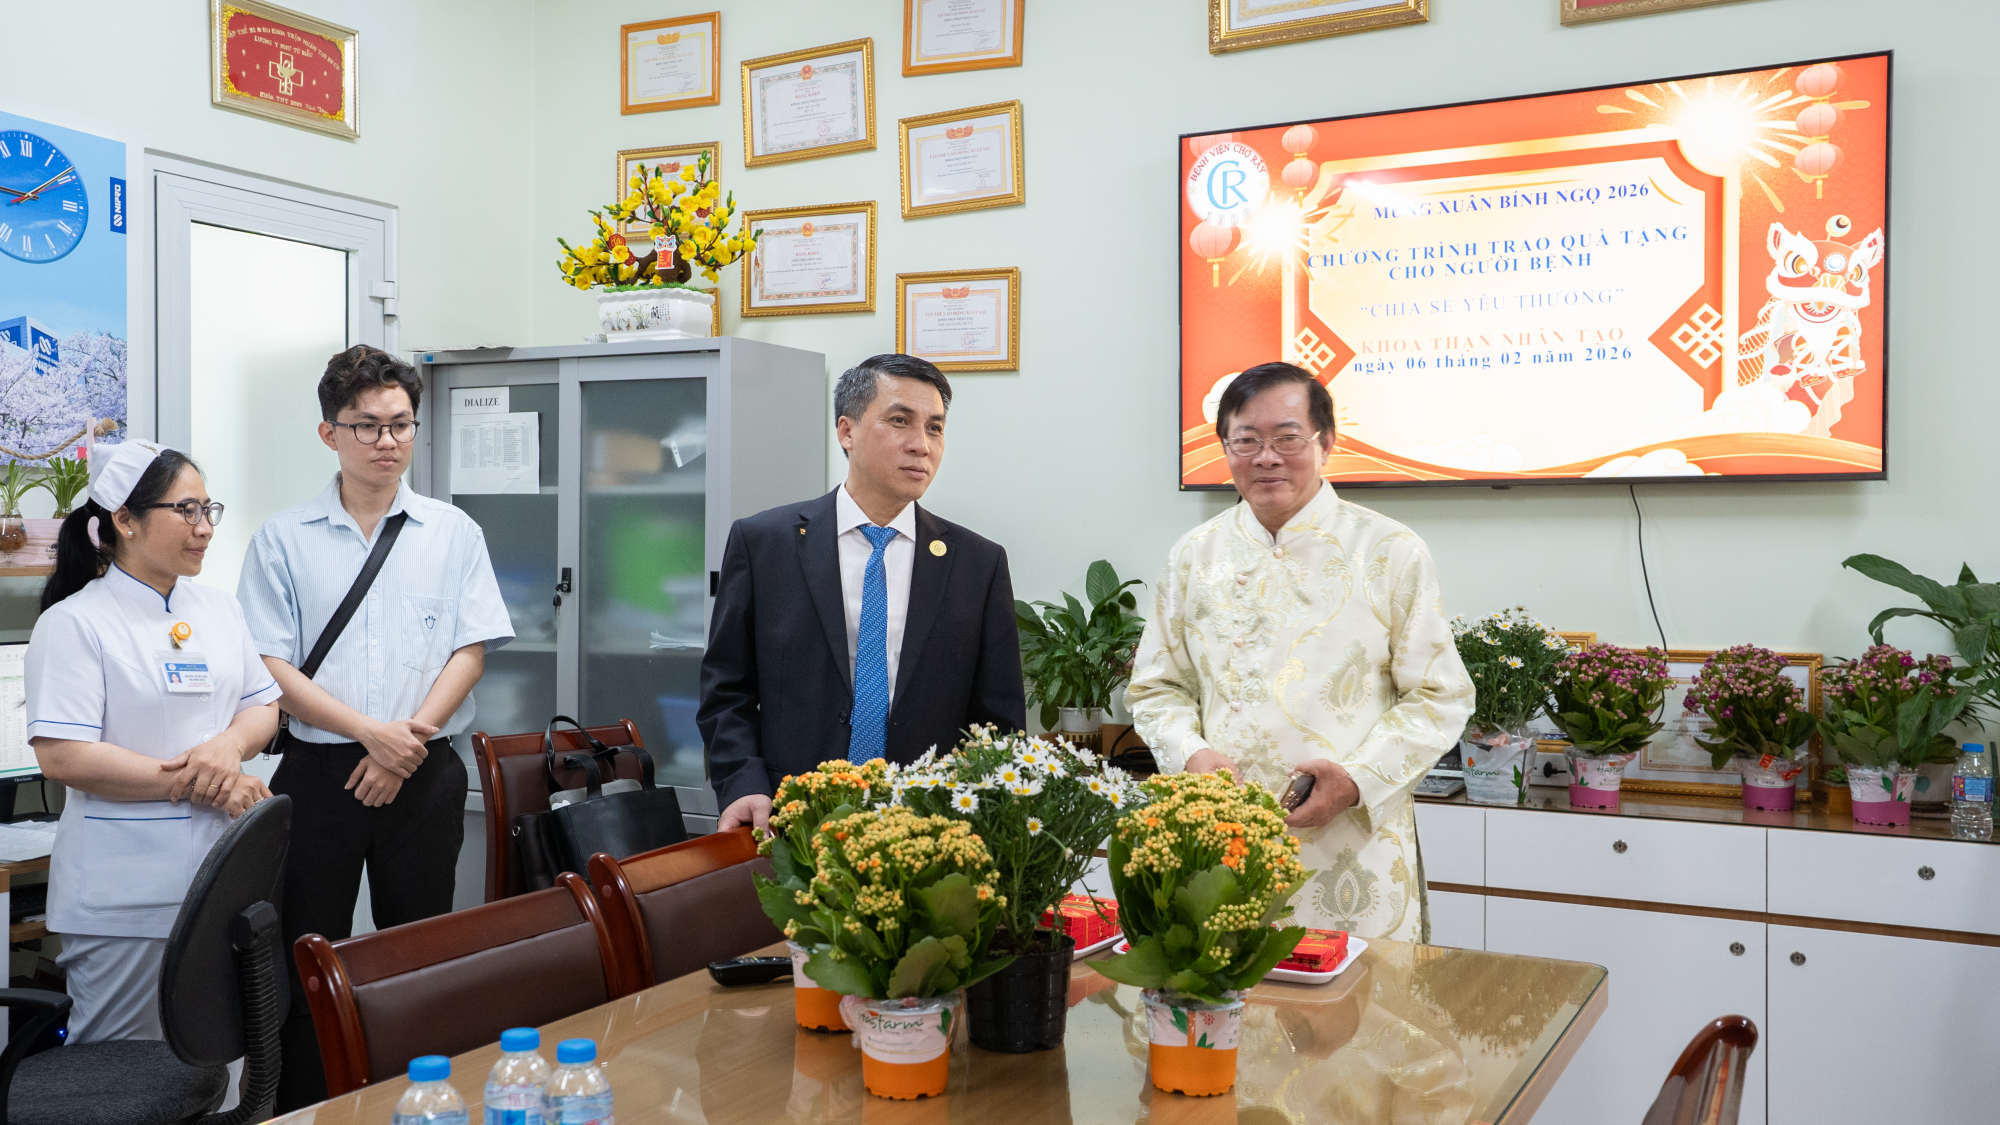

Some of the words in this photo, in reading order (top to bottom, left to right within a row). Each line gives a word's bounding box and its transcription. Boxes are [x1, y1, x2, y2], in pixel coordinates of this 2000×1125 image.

[271, 28, 286, 37] KHOA
[1190, 156, 1209, 182] BỆNH
[1209, 144, 1230, 157] VIỆN
[1233, 144, 1252, 158] CHỢ
[114, 184, 122, 214] NIPRO
[1438, 194, 1492, 214] XUÂN
[1500, 190, 1548, 209] BÍNH
[1556, 187, 1601, 205] NGỌ
[1608, 182, 1650, 200] 2026
[1308, 249, 1399, 268] CHƯƠNG
[1408, 242, 1477, 260] TRÌNH
[1488, 237, 1550, 254] TRAO
[1561, 228, 1609, 252] QUÀ
[1620, 226, 1688, 247] TẶNG
[1389, 264, 1435, 280] CHO
[1445, 254, 1518, 276] NGƯỜI
[1530, 252, 1591, 273] BỆNH
[1463, 294, 1505, 311] YÊU
[1362, 339, 1422, 354] KHOA
[1430, 333, 1490, 353] THẬN
[1502, 328, 1564, 347] NHÂN
[1576, 328, 1623, 346] TẠO
[1354, 358, 1396, 375] ngày
[1406, 356, 1426, 370] 06
[1437, 354, 1491, 370] tháng
[1501, 352, 1522, 366] 02
[1533, 350, 1573, 364] năm
[1585, 346, 1632, 362] 2026
[464, 398, 500, 407] DIALIZE
